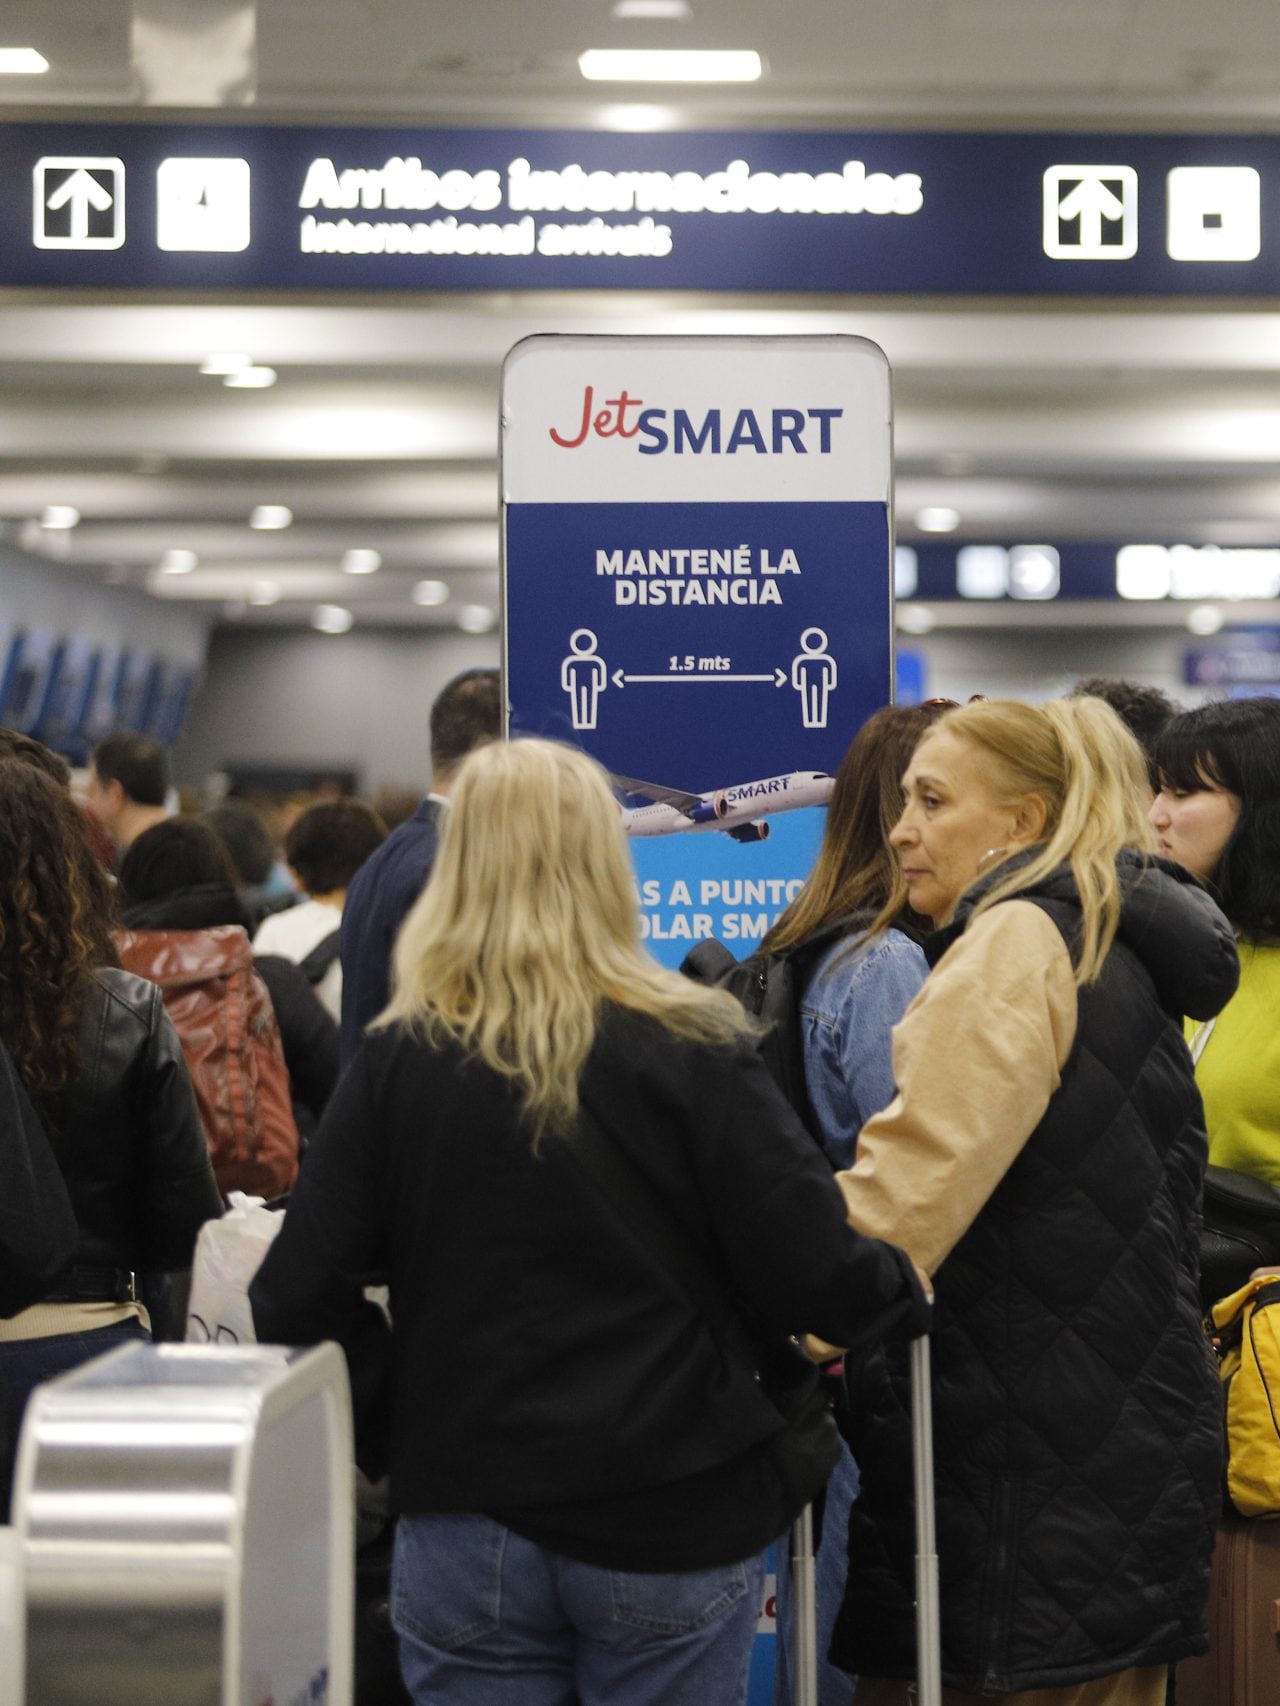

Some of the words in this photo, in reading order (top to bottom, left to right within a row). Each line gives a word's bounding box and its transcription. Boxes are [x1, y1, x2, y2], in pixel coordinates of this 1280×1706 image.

[595, 545, 753, 576] MANTENÉ
[760, 549, 802, 575] LA
[615, 578, 783, 606] DISTANCIA
[669, 656, 694, 672] 1.5
[698, 655, 731, 672] mts
[727, 776, 792, 802] SMART
[668, 880, 693, 906] A
[700, 879, 806, 906] PUNTO
